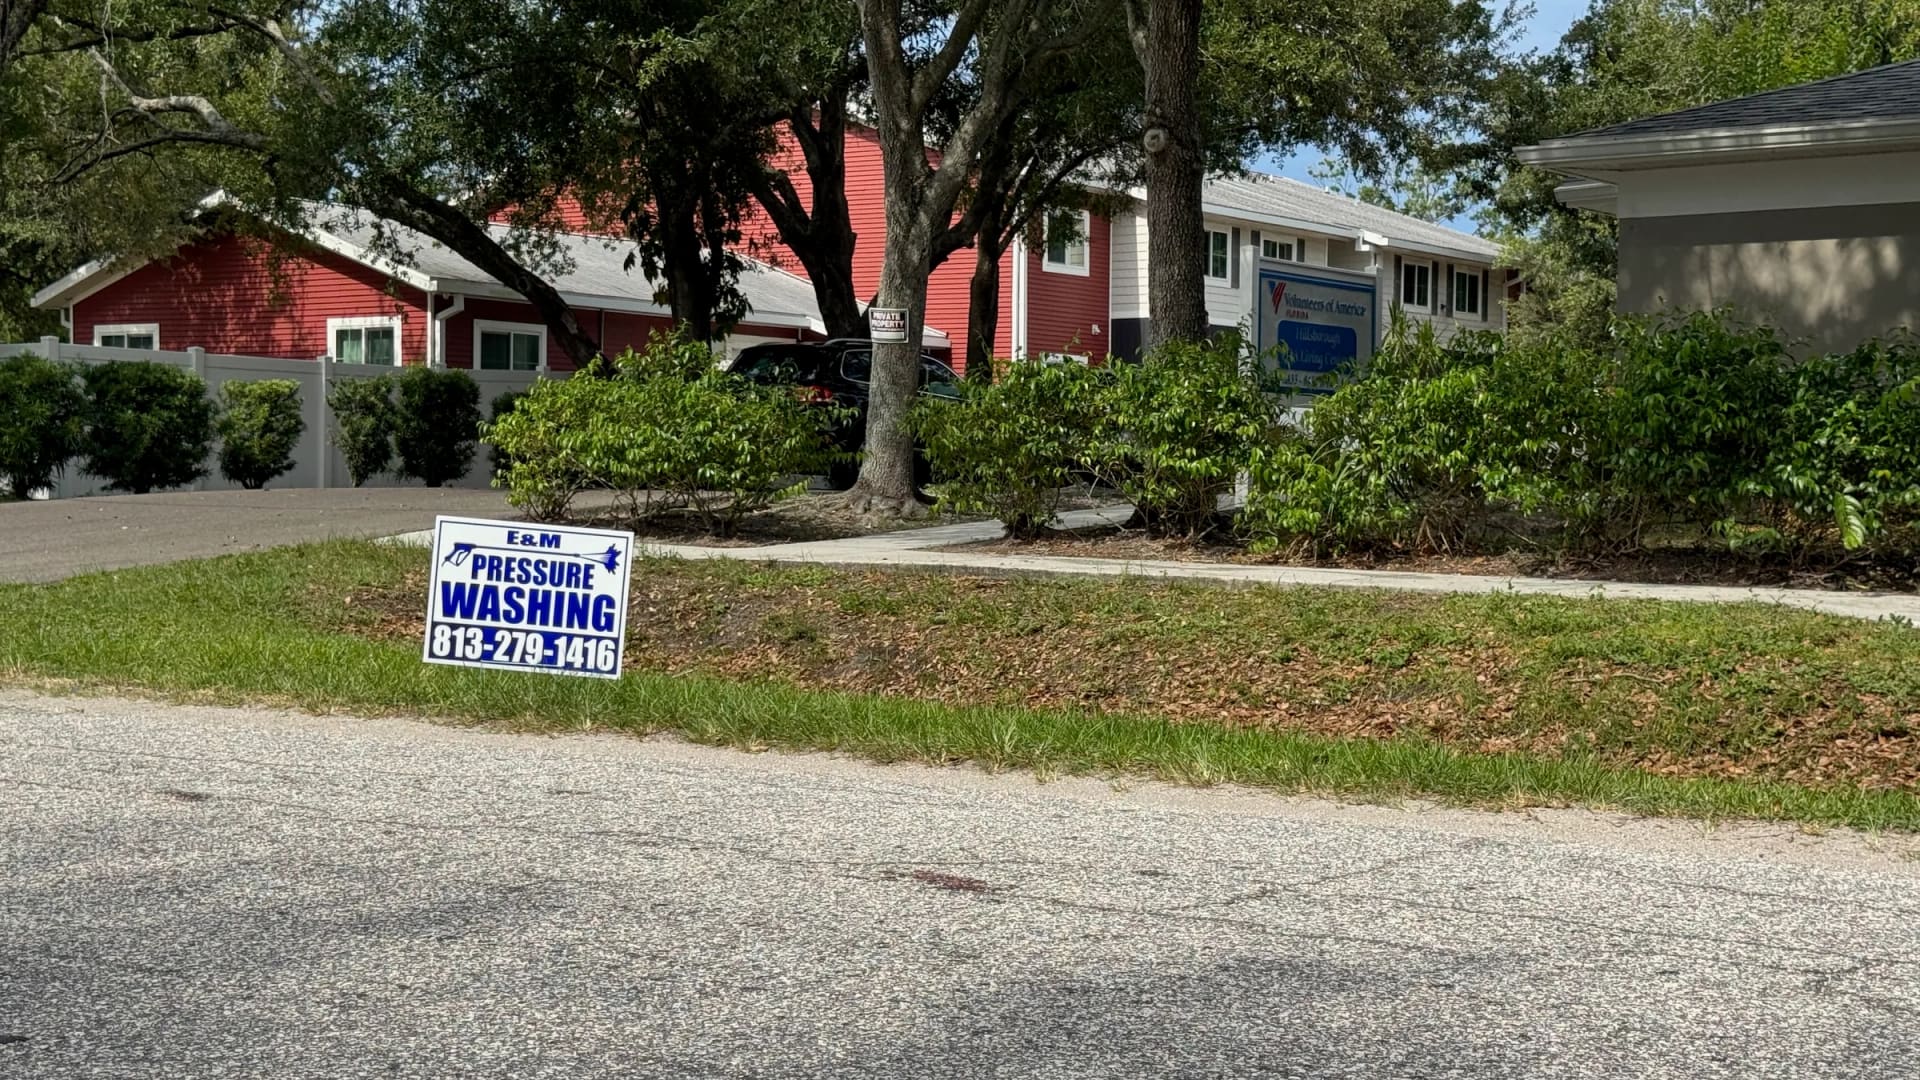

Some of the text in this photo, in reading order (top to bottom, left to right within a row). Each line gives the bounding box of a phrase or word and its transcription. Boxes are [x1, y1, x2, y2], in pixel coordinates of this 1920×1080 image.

[873, 312, 901, 320] PRIVATE
[1284, 292, 1367, 317] Volunteers of America
[871, 320, 905, 328] PROPERTY
[1296, 327, 1341, 349] Hillsborough
[506, 530, 562, 549] E&M
[471, 553, 596, 590] PRESSURE
[441, 580, 616, 633] WASHING
[432, 624, 616, 672] 813-279-1416
